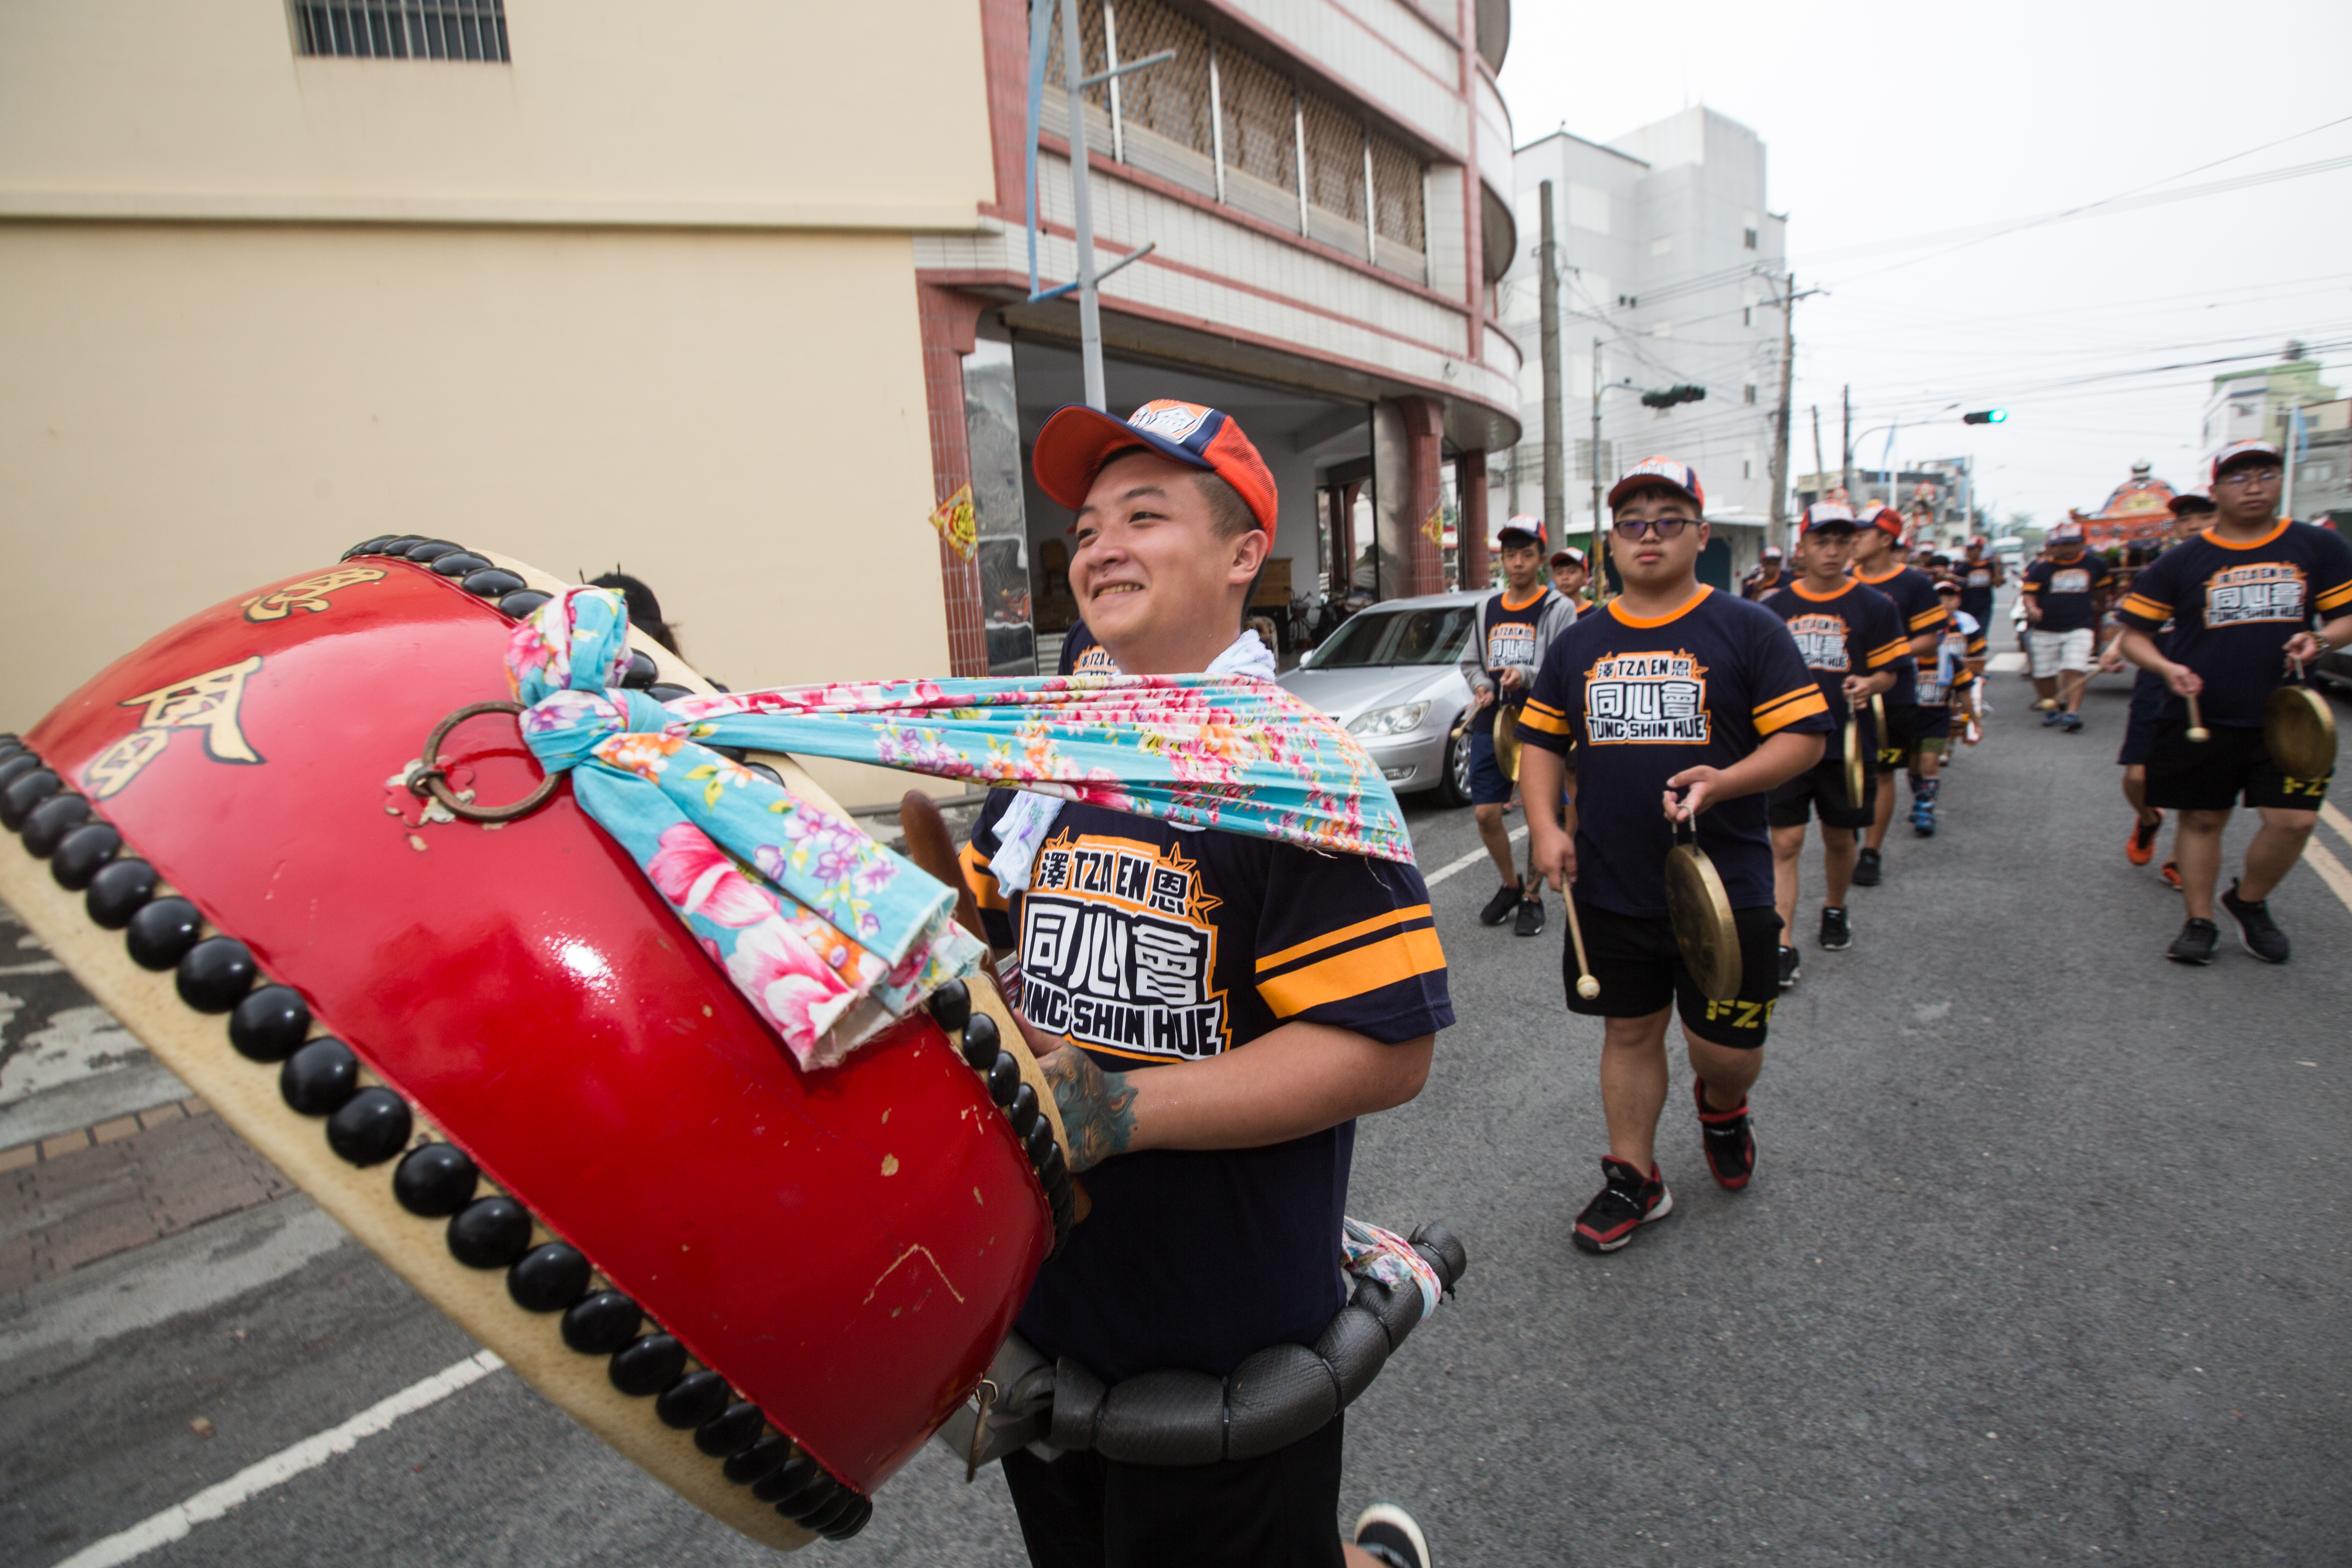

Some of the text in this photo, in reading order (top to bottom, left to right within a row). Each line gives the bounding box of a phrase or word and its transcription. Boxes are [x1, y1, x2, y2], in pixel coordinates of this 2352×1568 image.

[1588, 717, 1704, 739] TUNG SHIN HUE
[1590, 682, 1697, 721] 同心會
[1037, 850, 1070, 889] 澤
[1148, 866, 1188, 916] 恩
[1022, 902, 1200, 1006] 同心會
[1073, 998, 1145, 1051] SHIN
[1153, 1007, 1218, 1057] HUE
